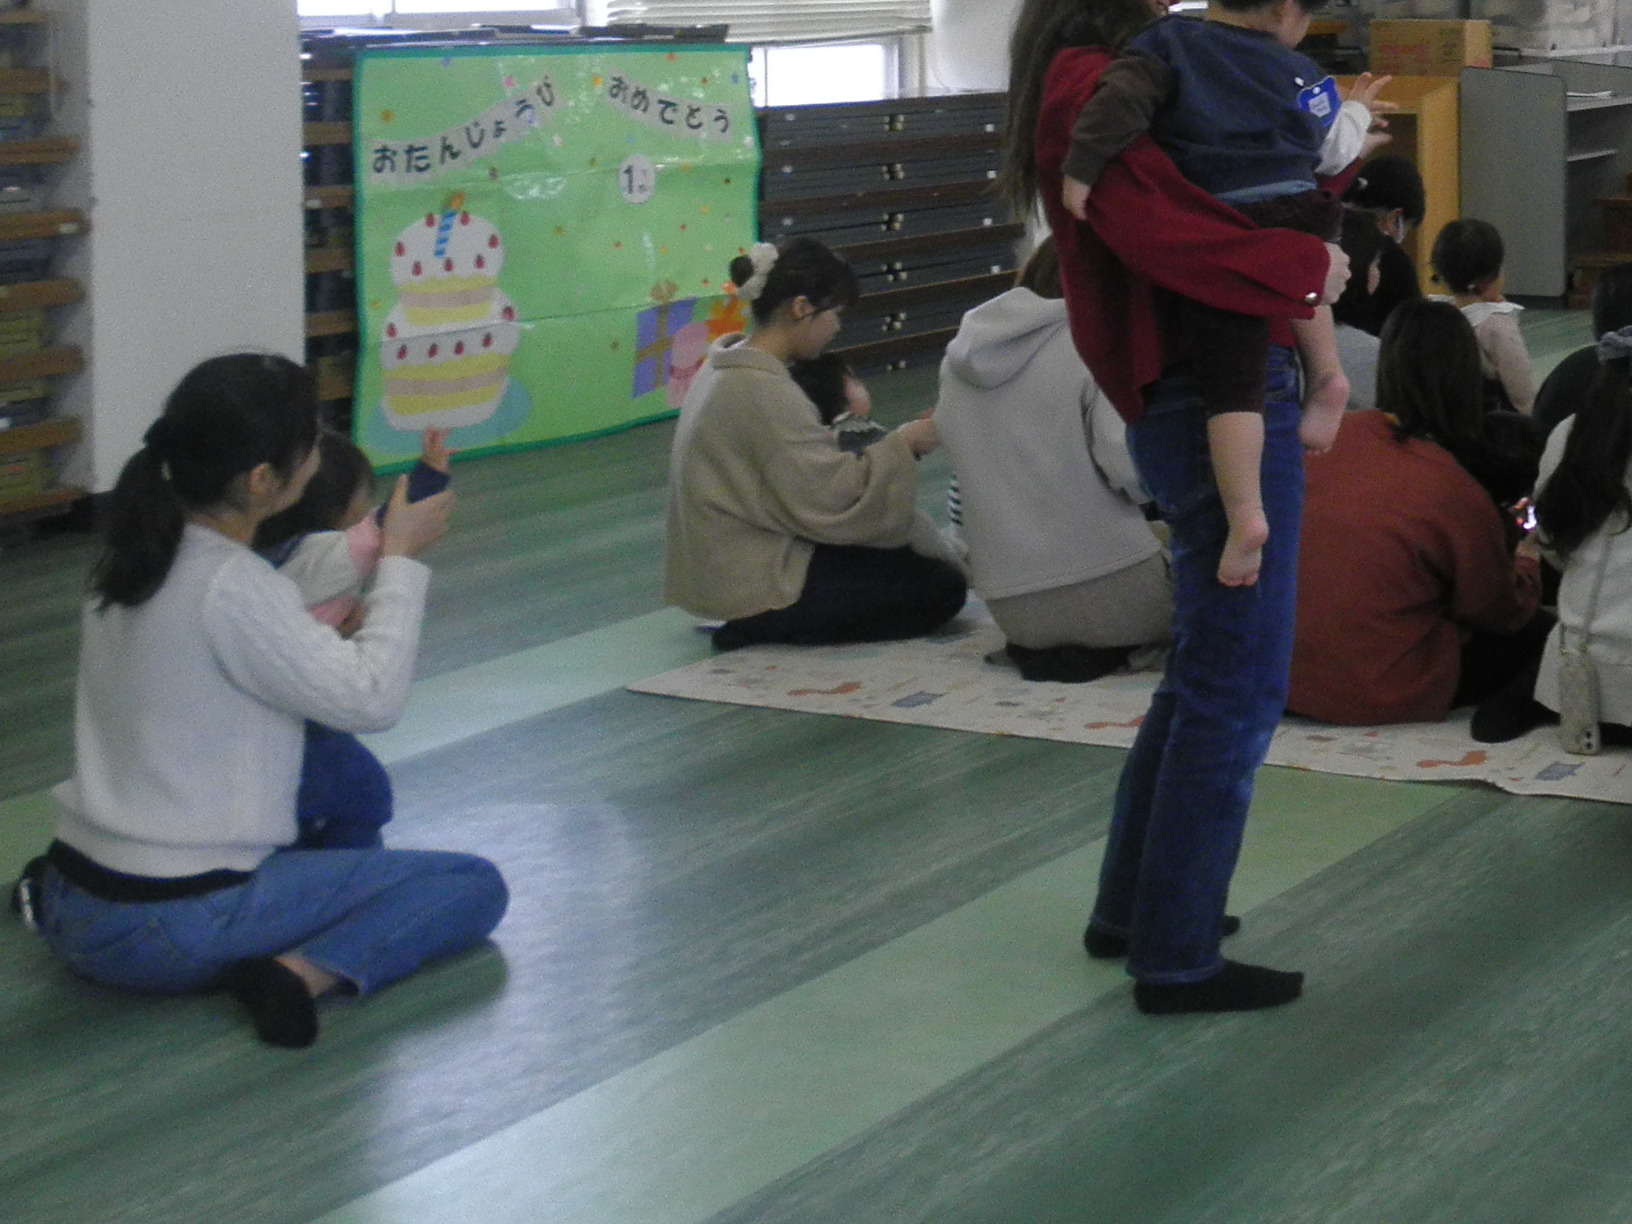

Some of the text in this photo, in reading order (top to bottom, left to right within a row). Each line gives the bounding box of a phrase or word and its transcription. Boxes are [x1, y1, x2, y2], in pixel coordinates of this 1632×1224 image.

[372, 75, 730, 174] おたんじょうび おめでとう
